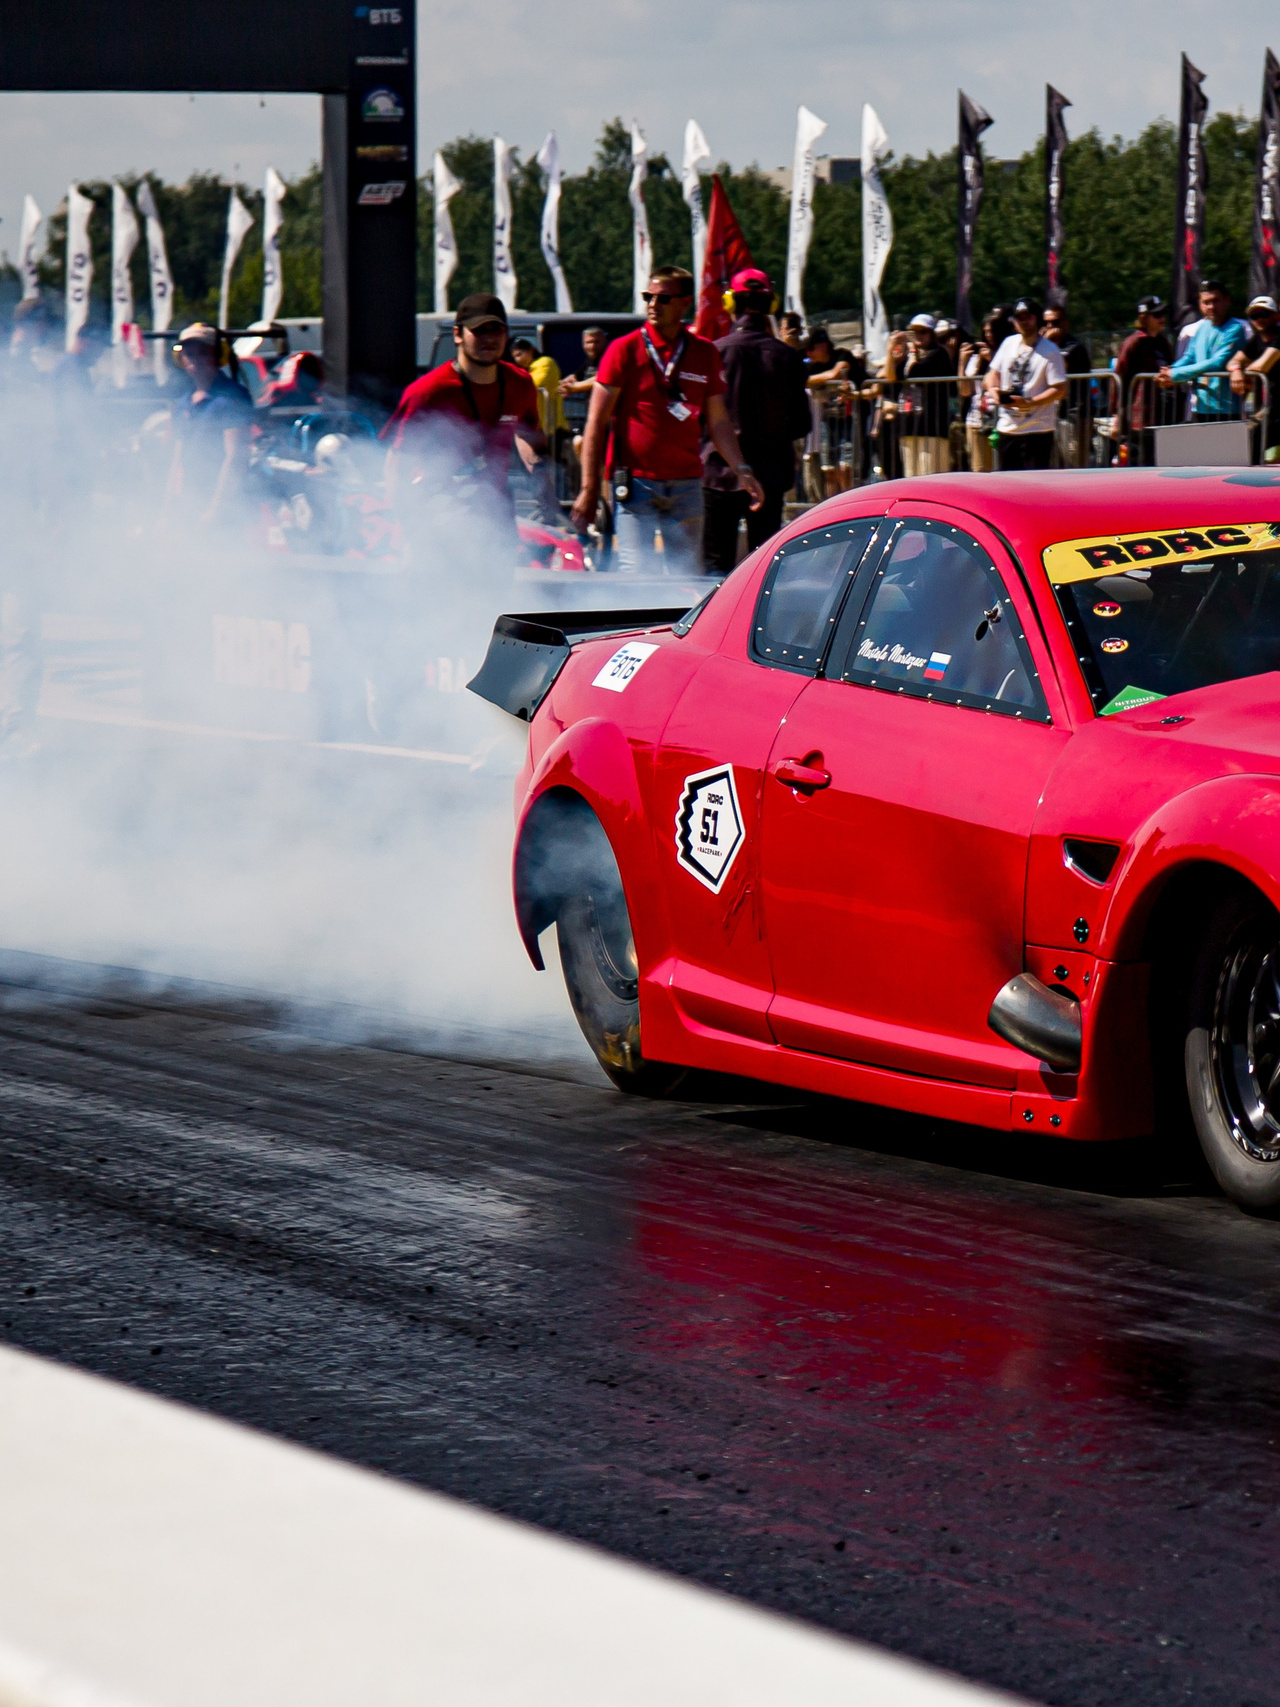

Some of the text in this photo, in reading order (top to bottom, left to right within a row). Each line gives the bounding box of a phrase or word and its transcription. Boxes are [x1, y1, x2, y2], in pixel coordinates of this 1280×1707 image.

[1075, 527, 1252, 570] RDRC
[610, 656, 642, 680] ВТБ
[1114, 695, 1155, 707] NITROUS
[707, 793, 724, 806] RDRC
[700, 808, 719, 846] 51
[699, 846, 721, 857] RACEPARK
